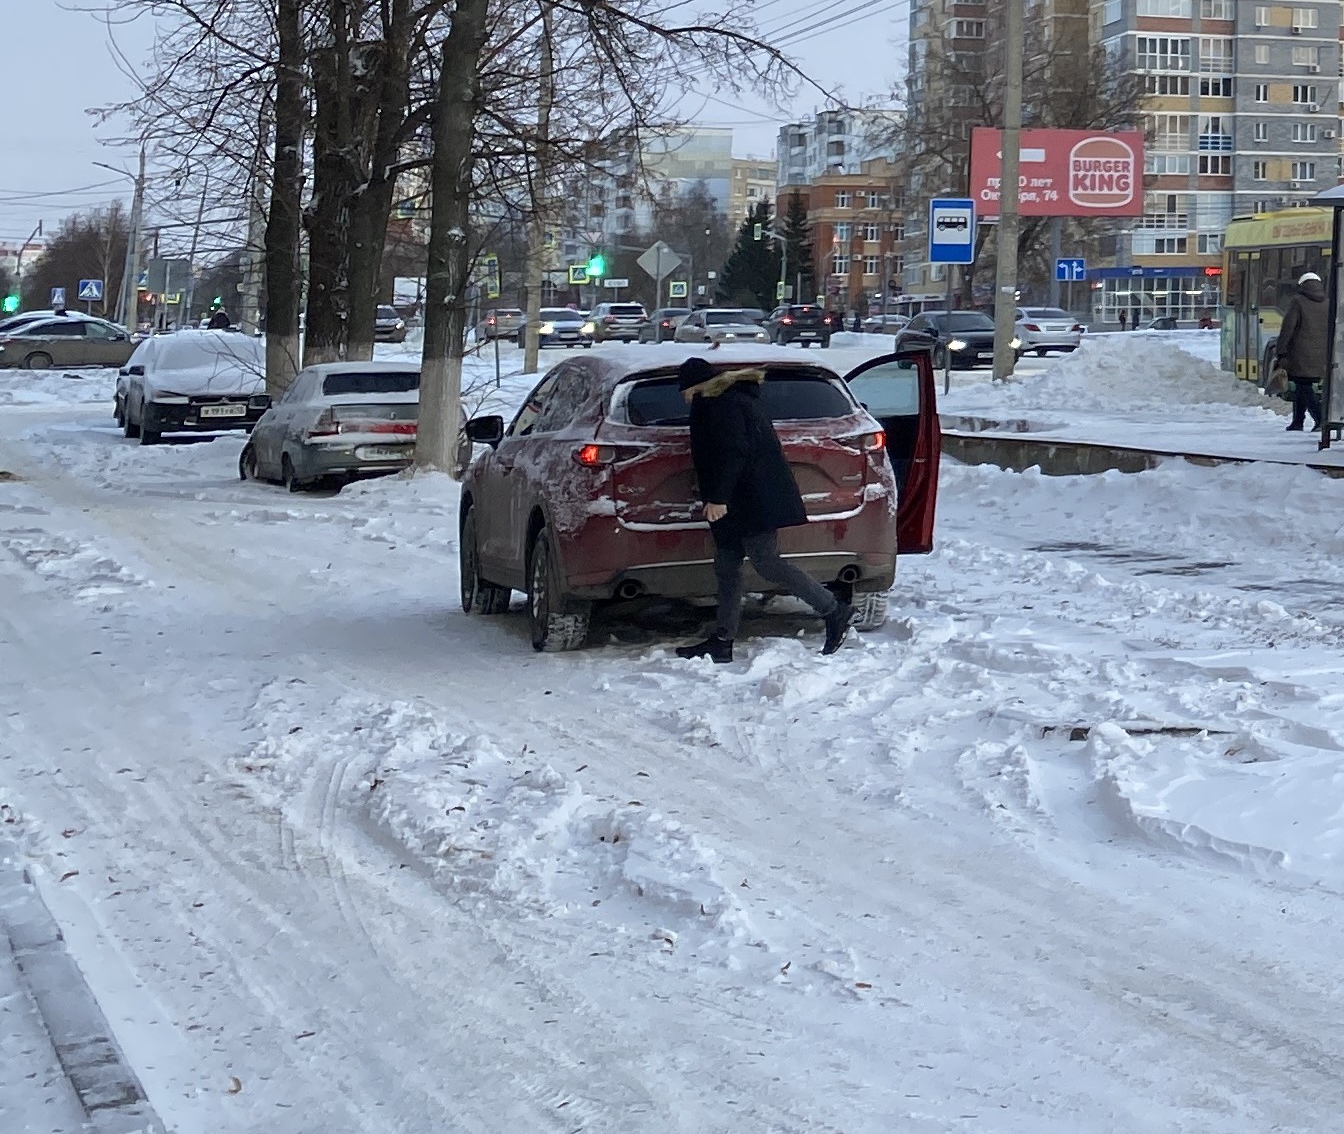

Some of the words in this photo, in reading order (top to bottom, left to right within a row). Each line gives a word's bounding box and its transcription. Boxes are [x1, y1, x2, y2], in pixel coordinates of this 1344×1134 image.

[1072, 160, 1131, 173] BURGER
[1029, 178, 1053, 187] лет
[1072, 173, 1130, 192] KING
[1042, 190, 1059, 201] 74
